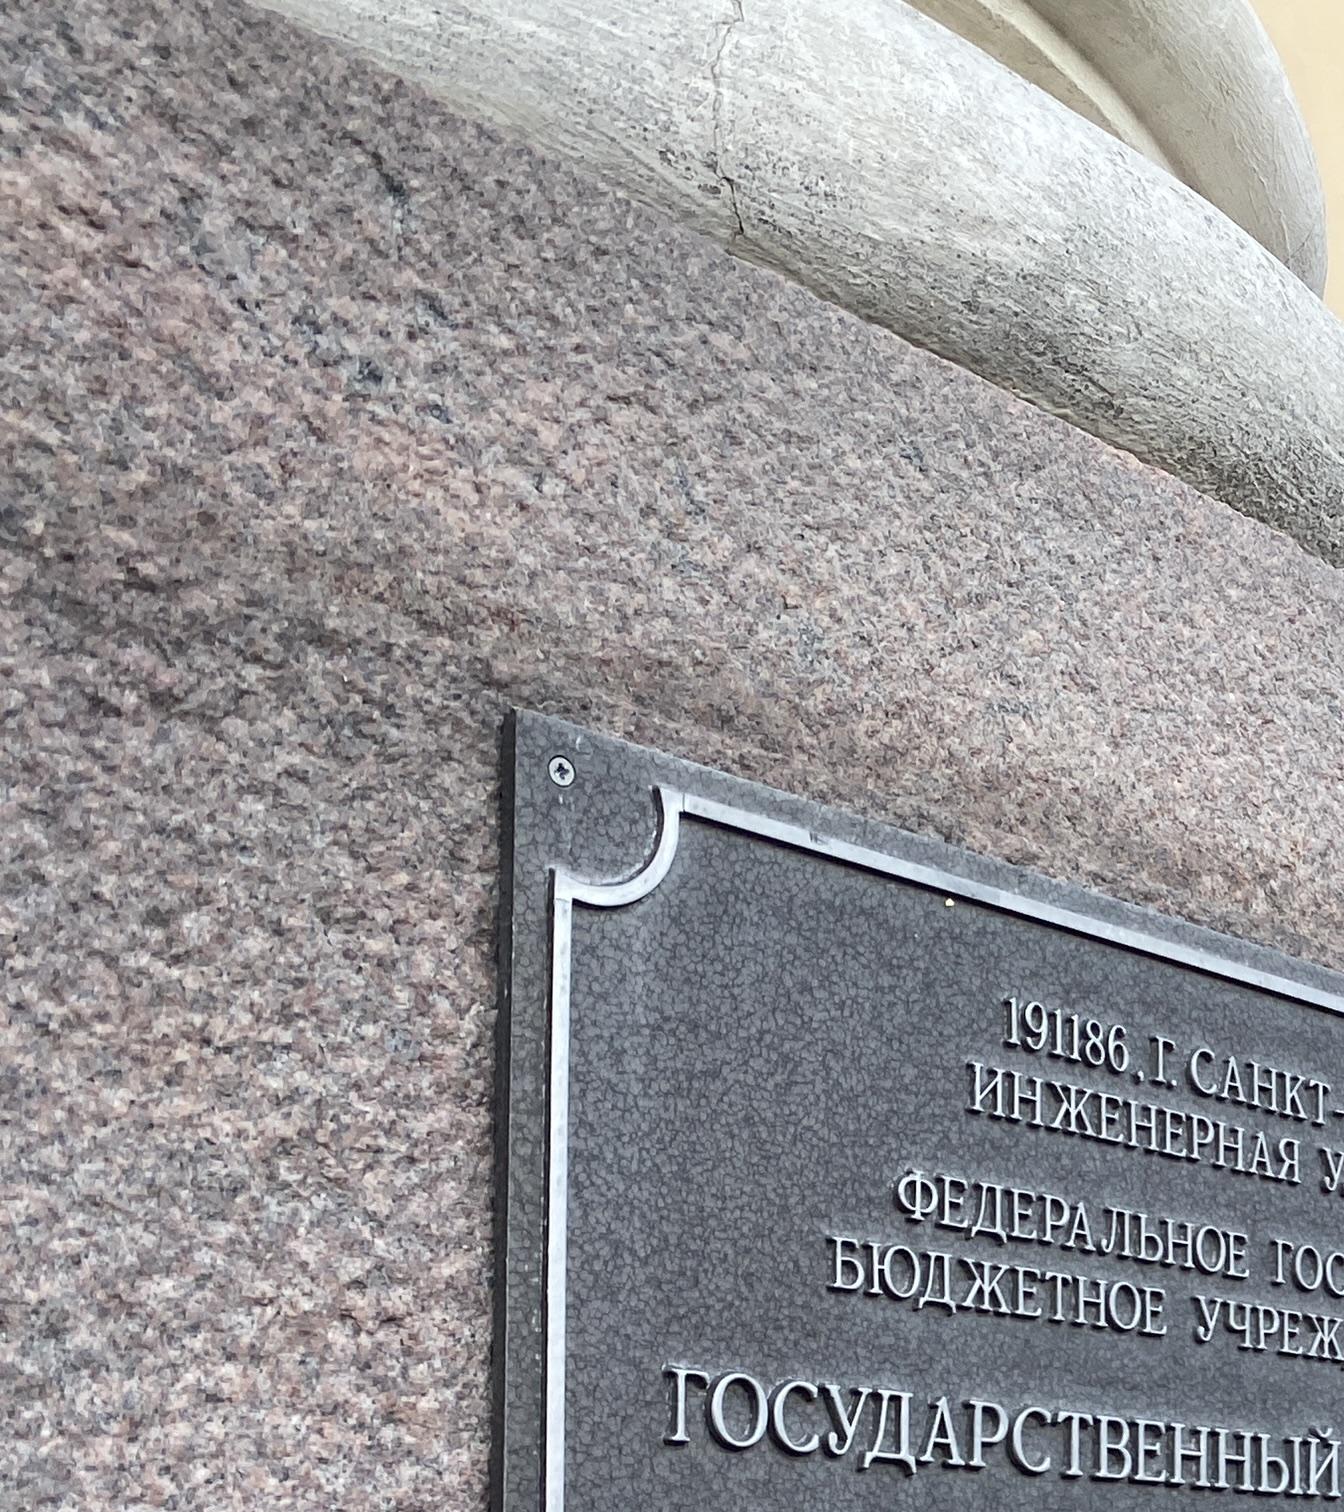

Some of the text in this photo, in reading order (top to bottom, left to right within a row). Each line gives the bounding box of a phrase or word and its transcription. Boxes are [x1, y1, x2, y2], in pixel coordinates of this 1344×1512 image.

[966, 1061, 1302, 1183] ИНЖЕНЕРНАЯ
[897, 1169, 1249, 1279] ФЕДЕРАЛЬНОЕ
[829, 1237, 1167, 1337] БЮДЖЕТНОЕ
[663, 1365, 1342, 1500] ГОСУДАРСТВЕННЫЙ
